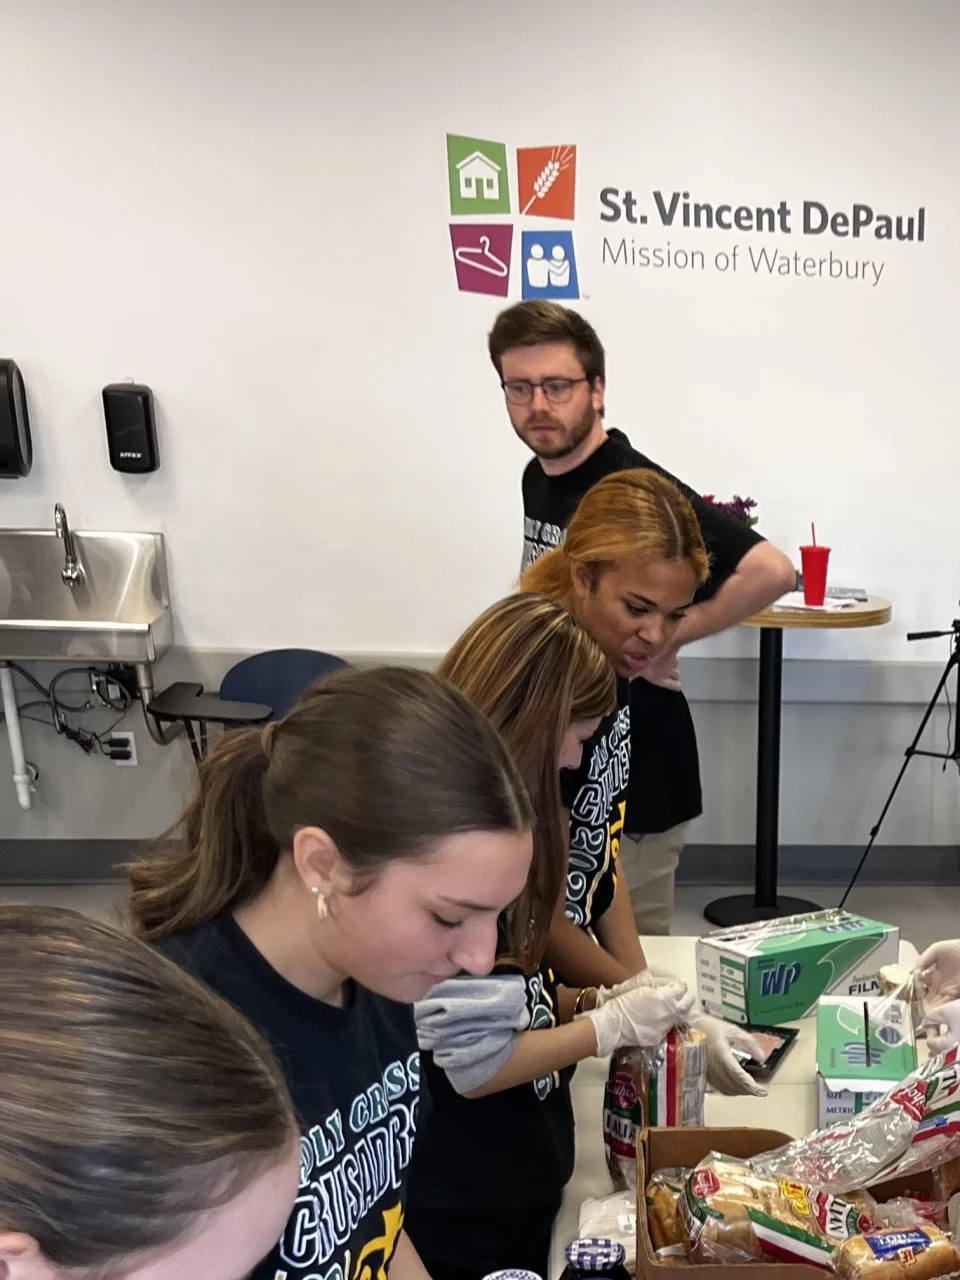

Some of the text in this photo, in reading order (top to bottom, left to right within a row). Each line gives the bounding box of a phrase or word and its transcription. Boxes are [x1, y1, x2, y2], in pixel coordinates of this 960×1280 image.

[599, 187, 926, 242] St. Vincent DePaul
[601, 236, 885, 285] Mission of Waterbury
[760, 961, 802, 997] WP
